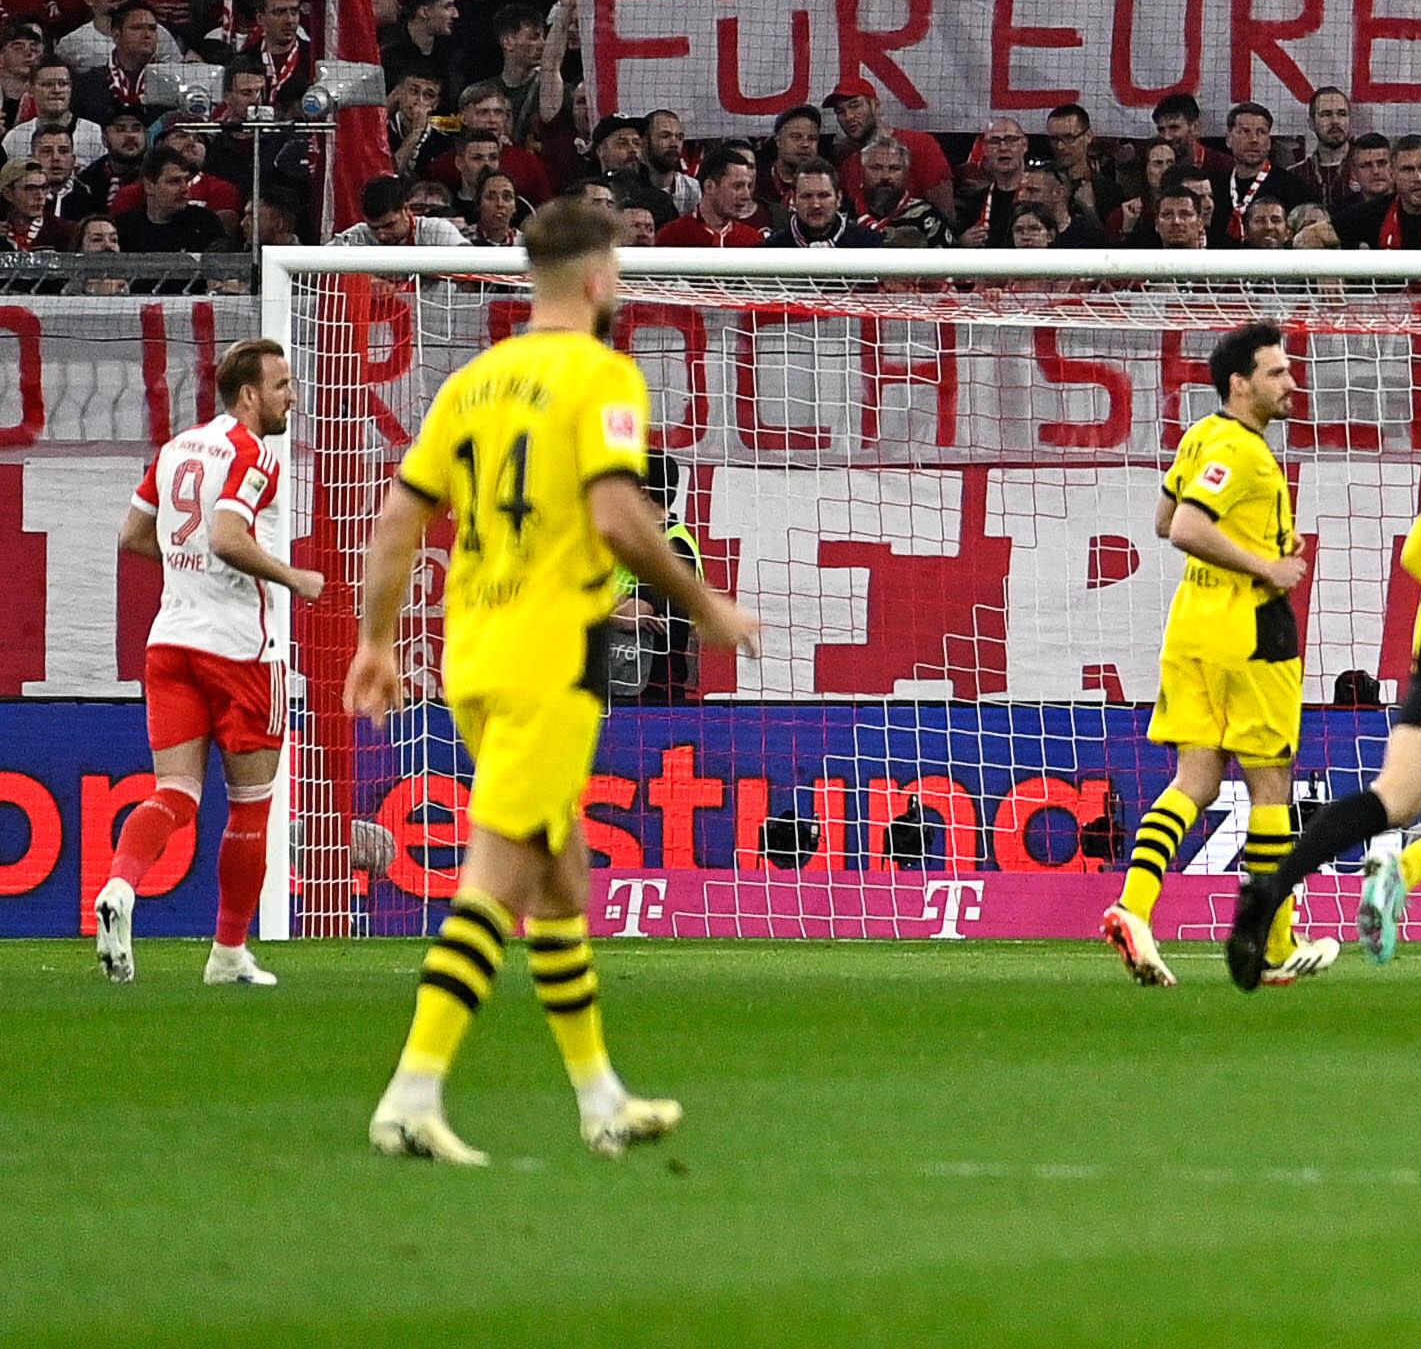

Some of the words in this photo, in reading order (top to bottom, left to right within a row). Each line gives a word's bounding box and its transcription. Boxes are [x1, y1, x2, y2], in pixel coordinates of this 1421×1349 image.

[171, 459, 207, 547] 9
[455, 431, 534, 553] 14
[163, 550, 207, 573] KANE
